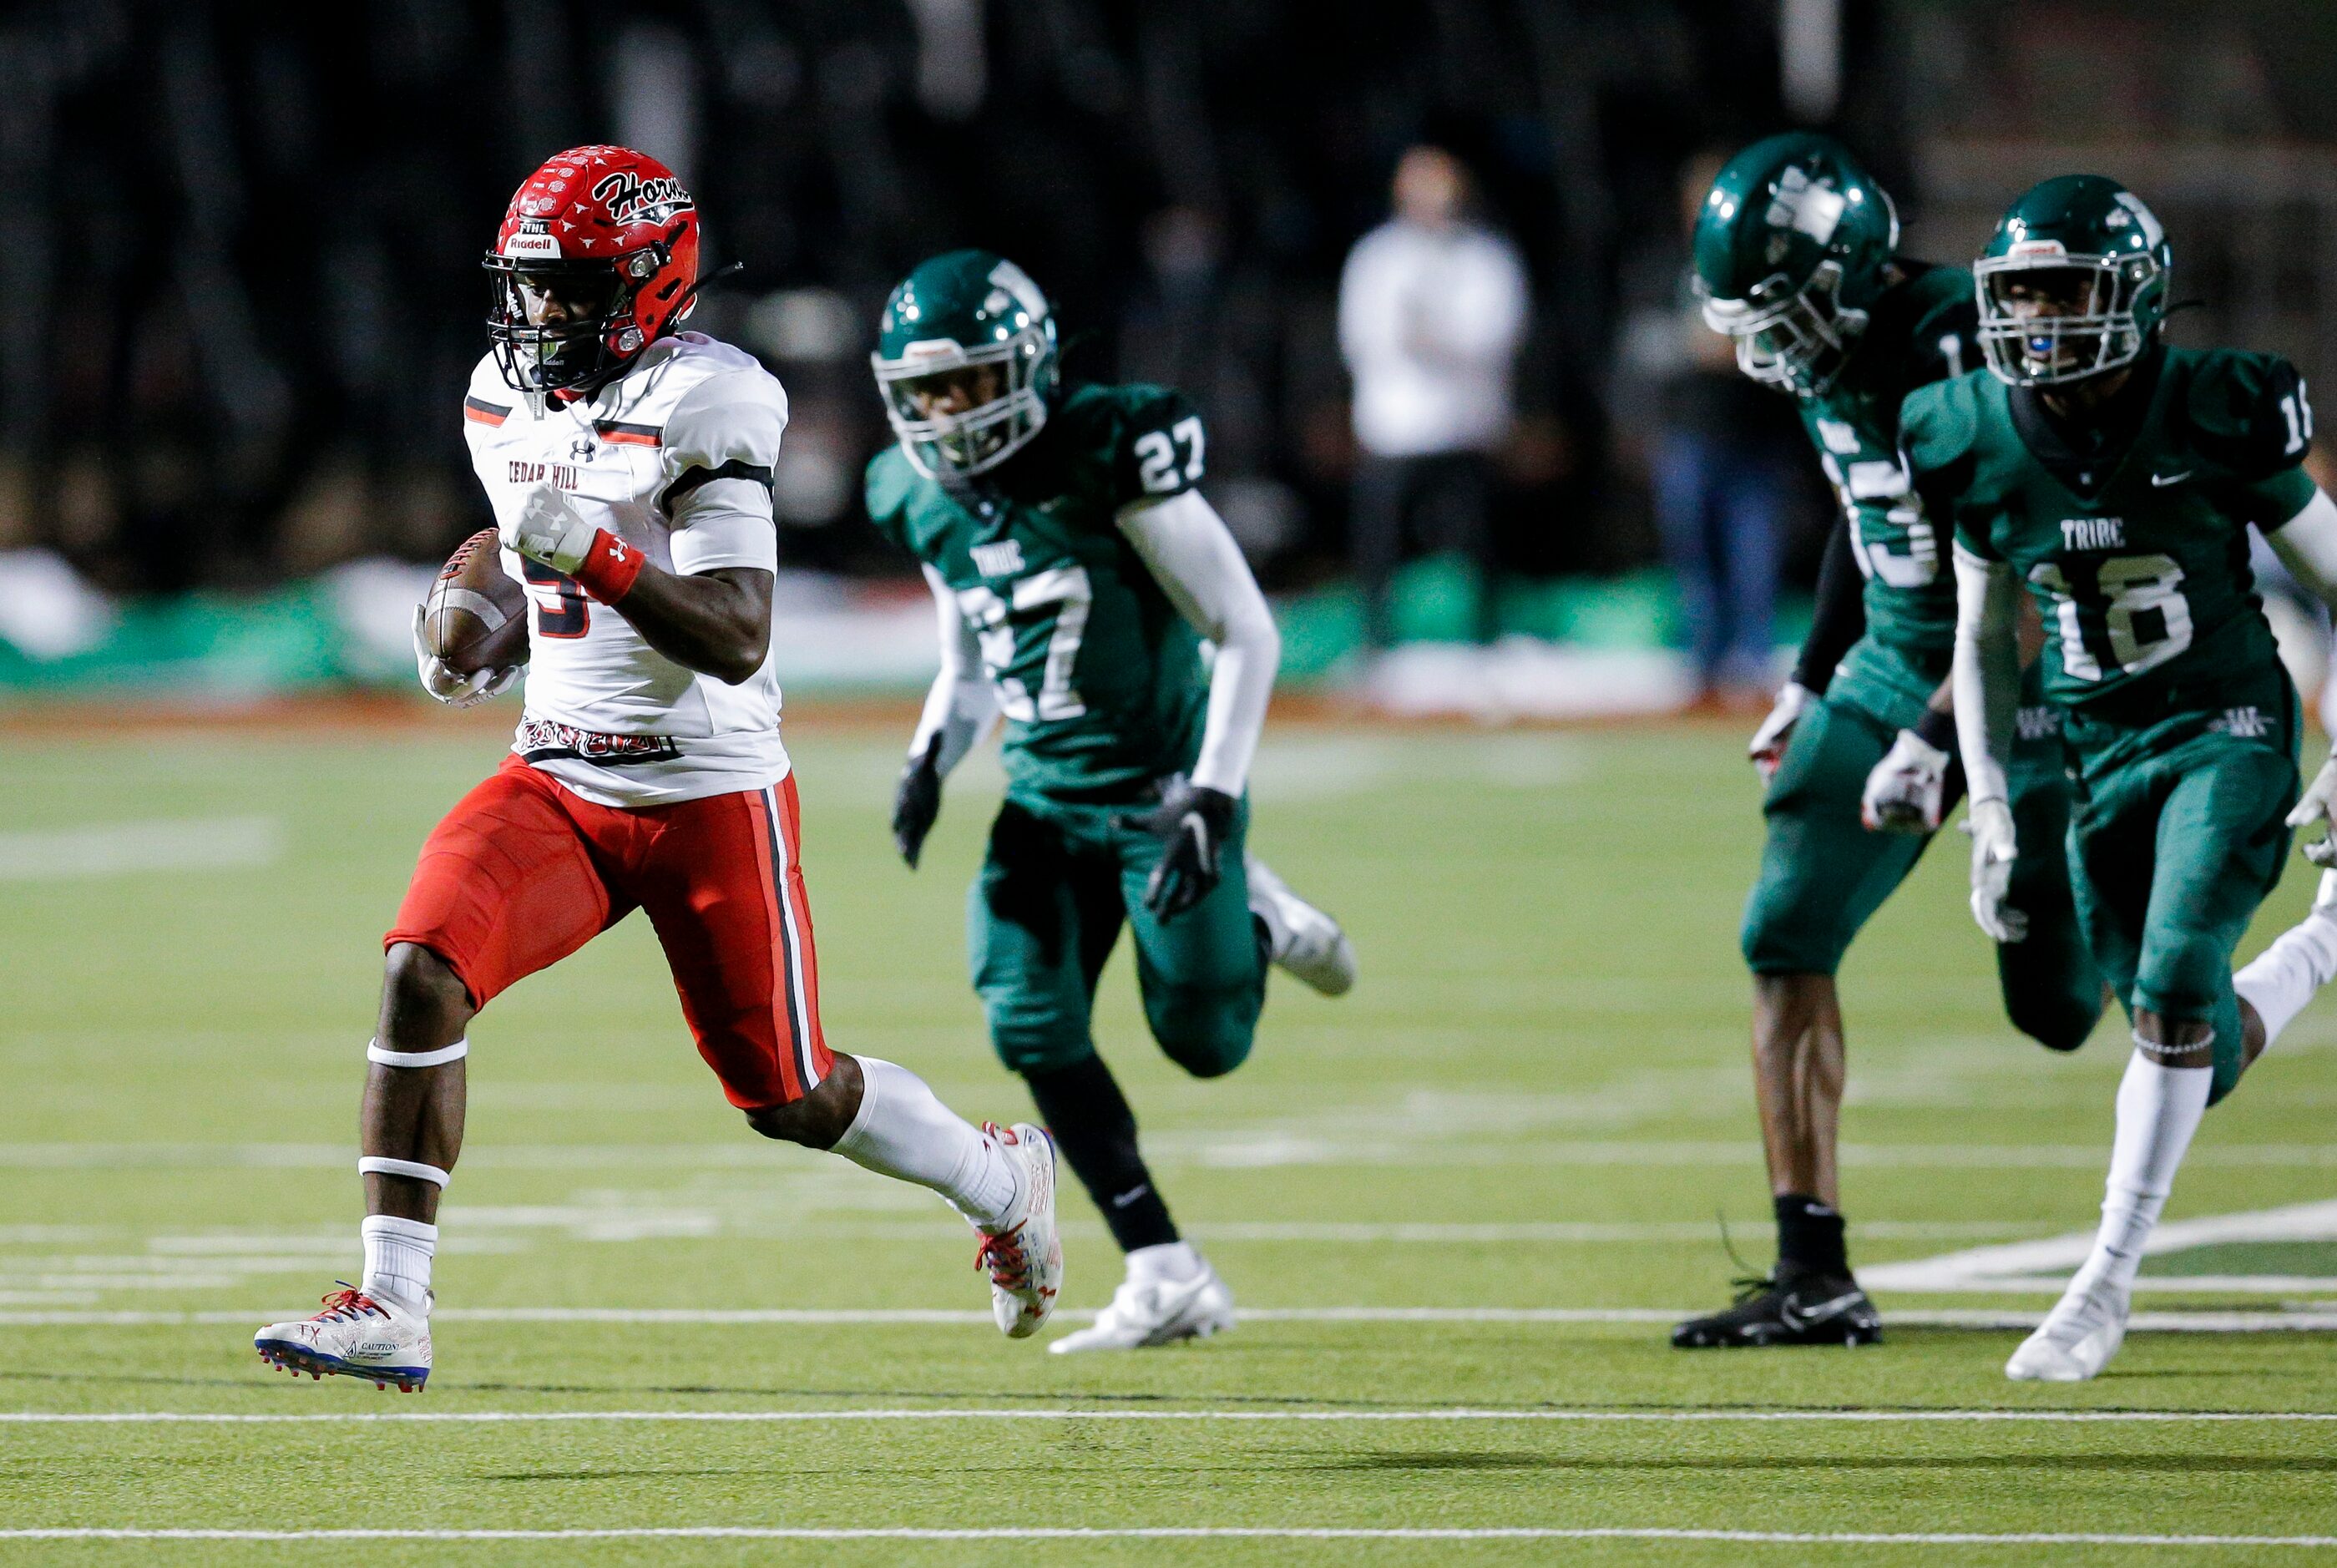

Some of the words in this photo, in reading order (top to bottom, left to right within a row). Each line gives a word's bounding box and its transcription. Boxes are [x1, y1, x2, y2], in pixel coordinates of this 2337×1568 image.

[519, 222, 546, 235] FTHL
[510, 238, 551, 250] Riddell
[1134, 416, 1205, 493] 27
[508, 460, 545, 483] CEDAR
[552, 464, 579, 490] HILL
[2027, 553, 2194, 682] 18
